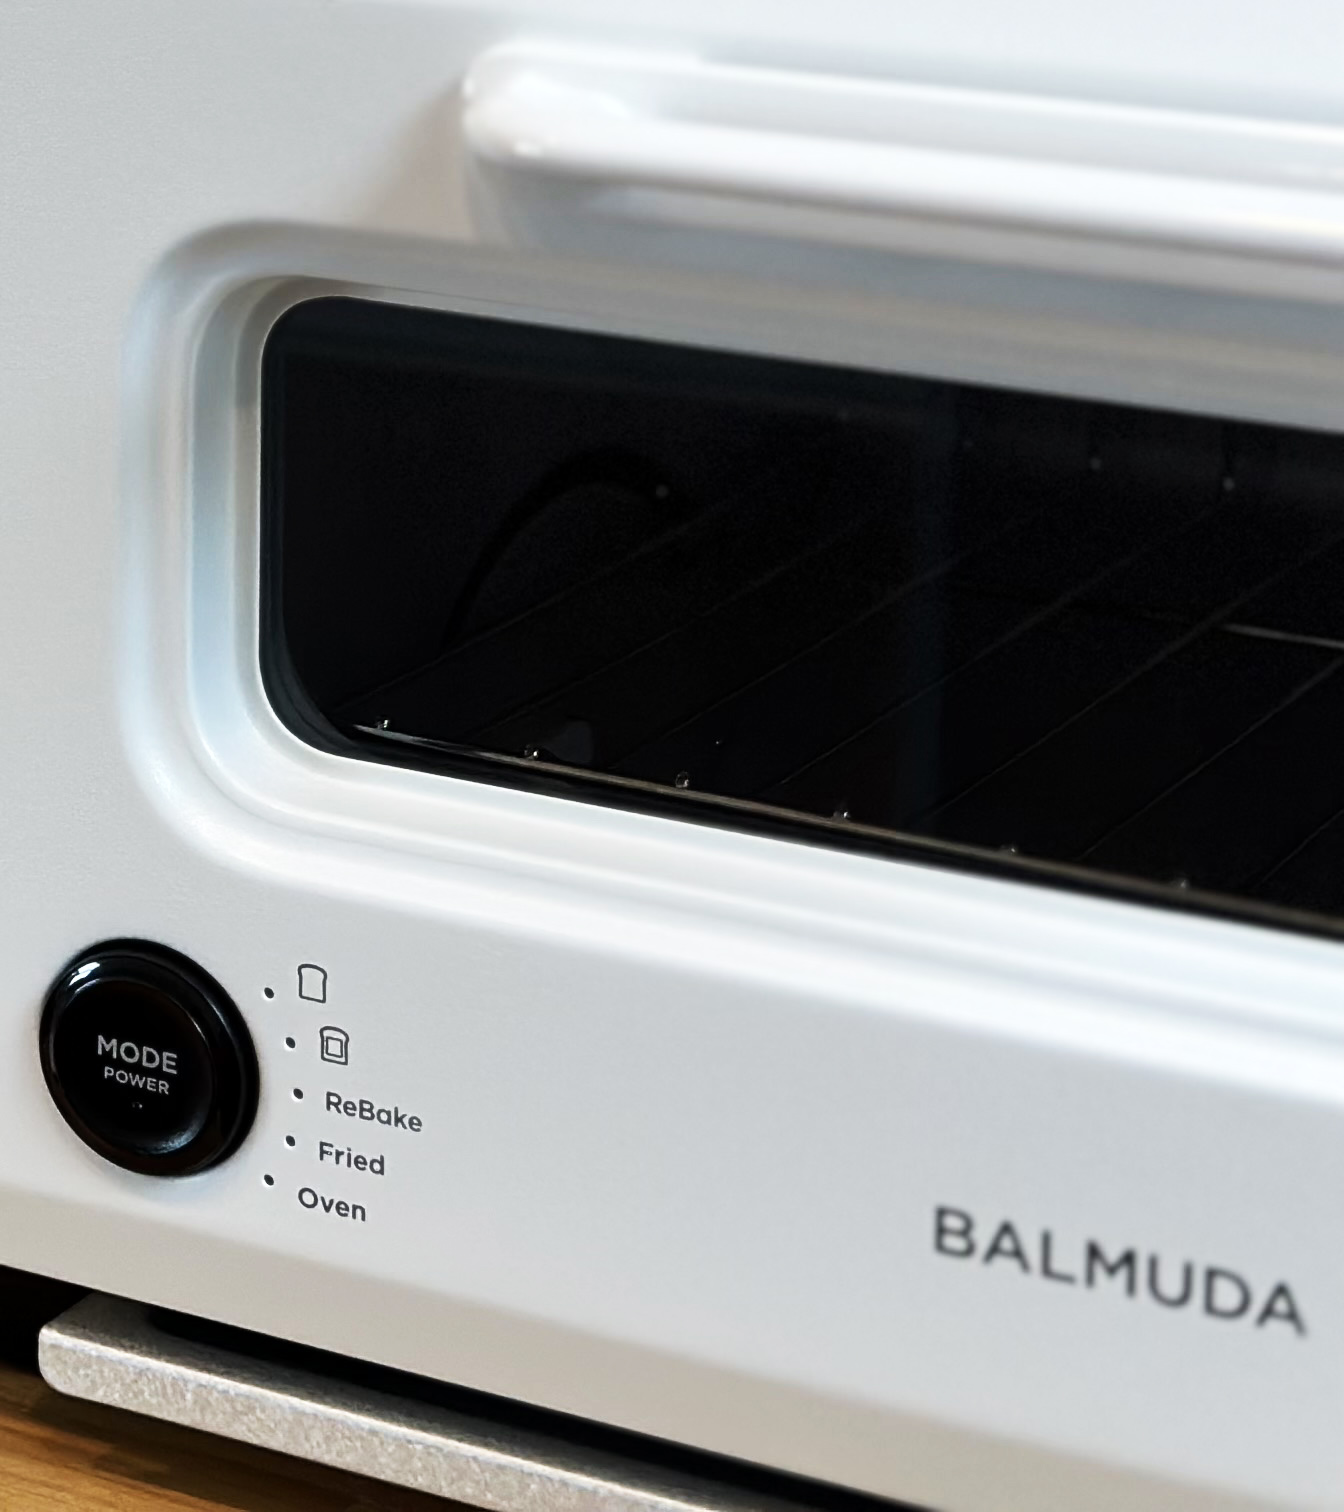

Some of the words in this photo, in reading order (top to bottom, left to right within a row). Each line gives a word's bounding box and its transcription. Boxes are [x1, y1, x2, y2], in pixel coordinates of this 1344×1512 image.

[97, 1034, 178, 1075] MODE
[103, 1065, 171, 1096] POWER
[324, 1090, 424, 1134] ReBake
[318, 1140, 386, 1176] Fried
[297, 1187, 367, 1222] Oven
[932, 1203, 1308, 1338] BALMUDA
